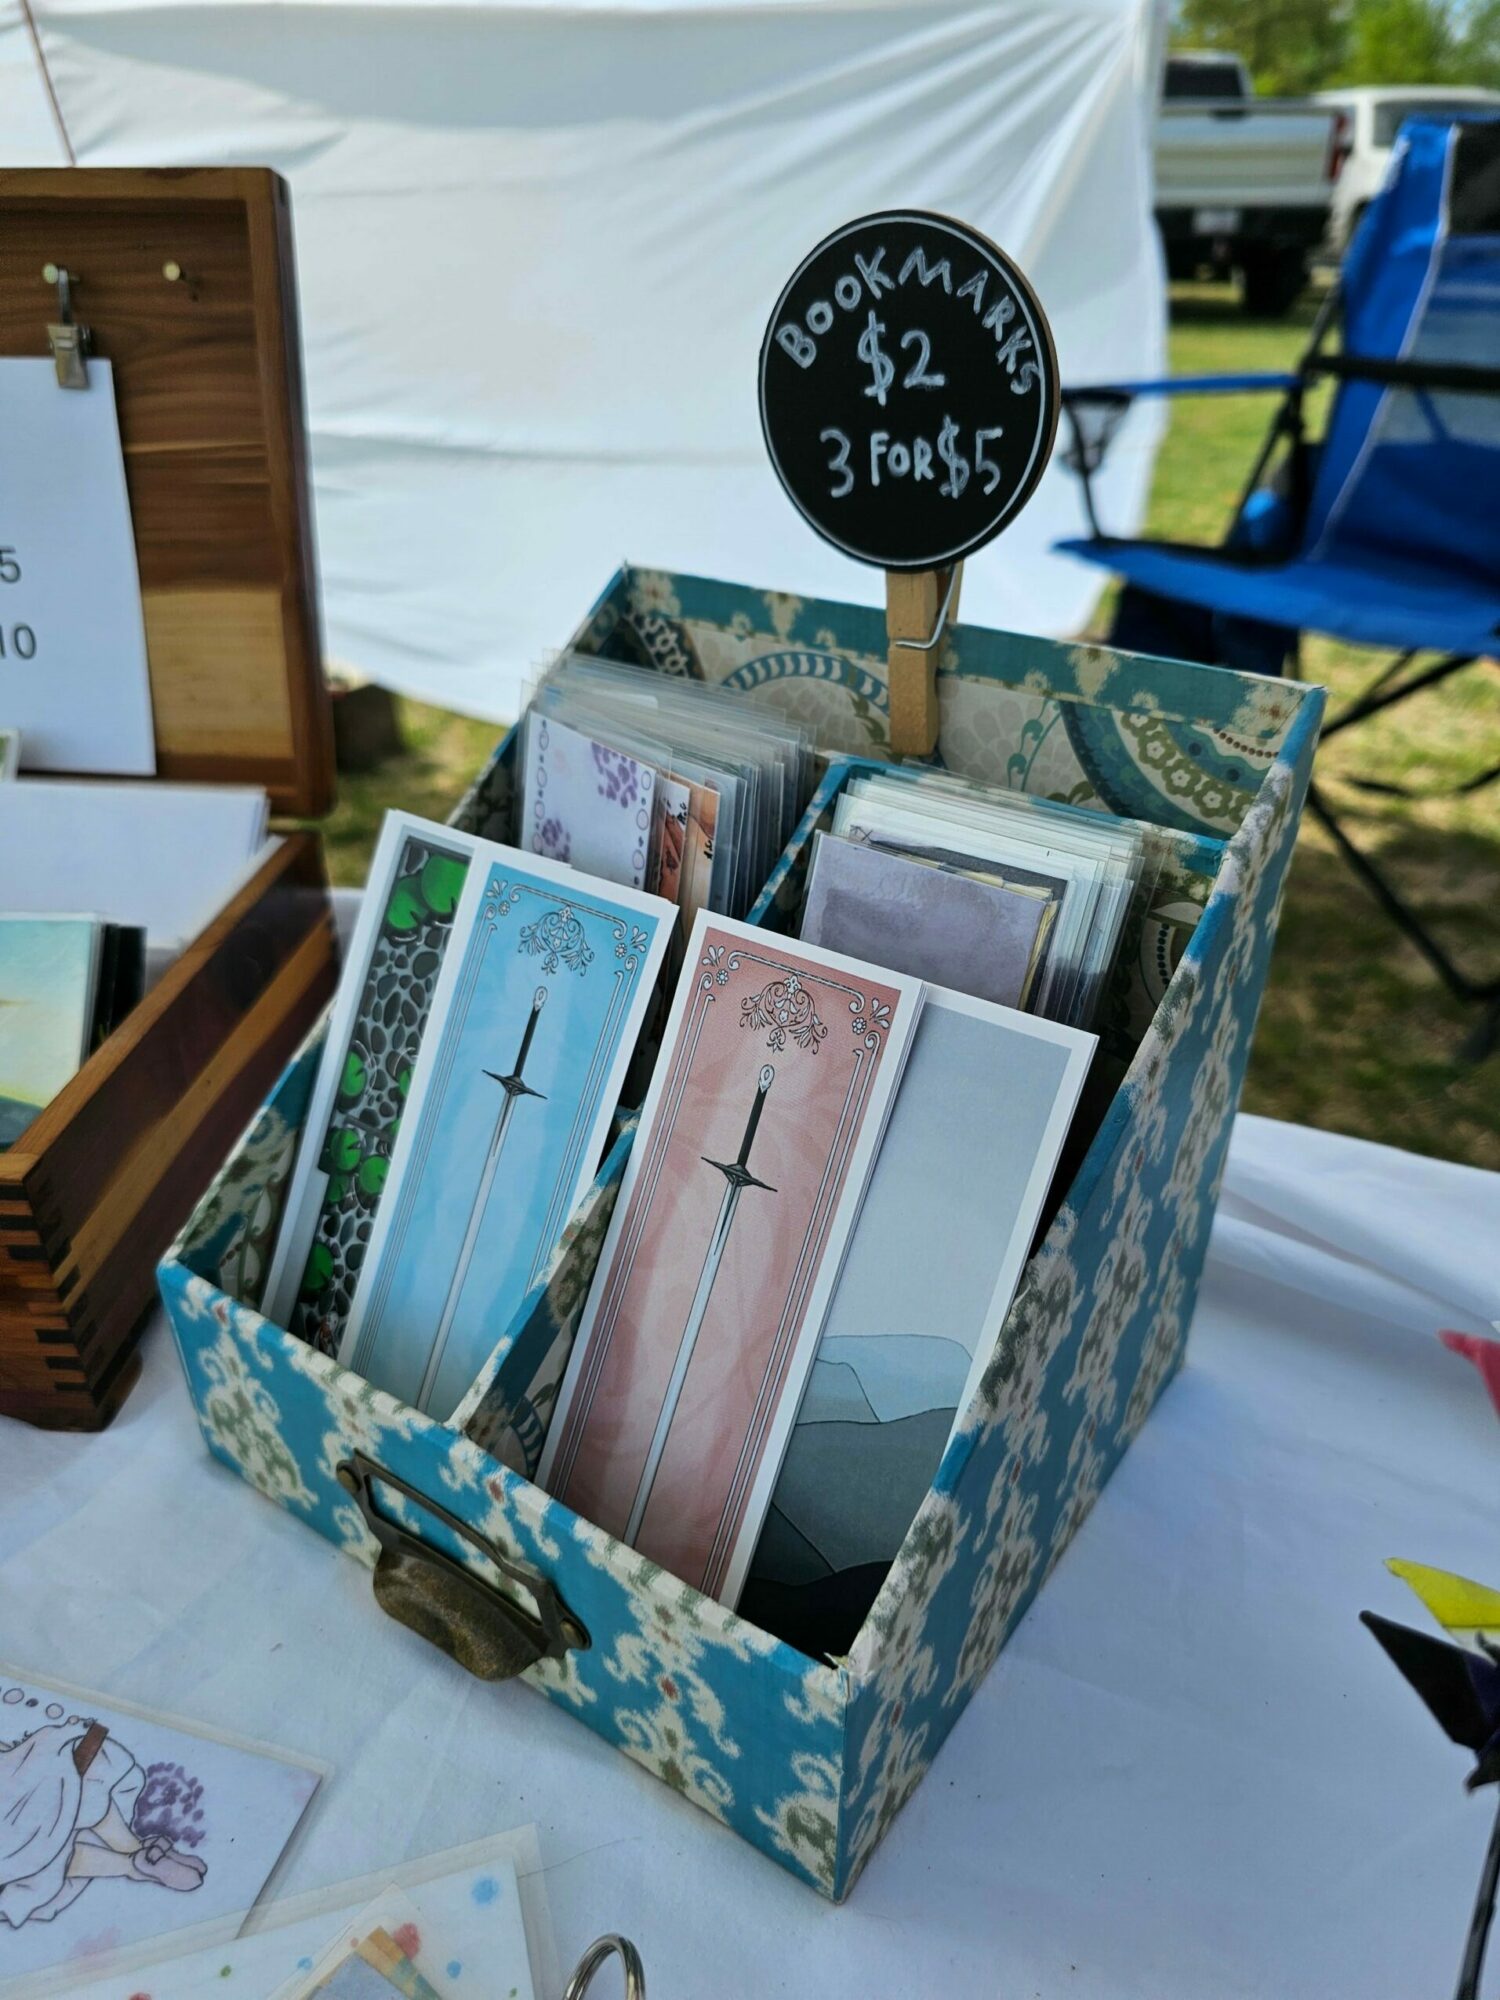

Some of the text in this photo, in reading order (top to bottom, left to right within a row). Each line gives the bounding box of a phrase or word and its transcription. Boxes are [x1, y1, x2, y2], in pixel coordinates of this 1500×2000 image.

[776, 246, 1041, 395] BOOKMARKS
[857, 310, 945, 406] $2
[820, 414, 1003, 499] 3 FOR $5
